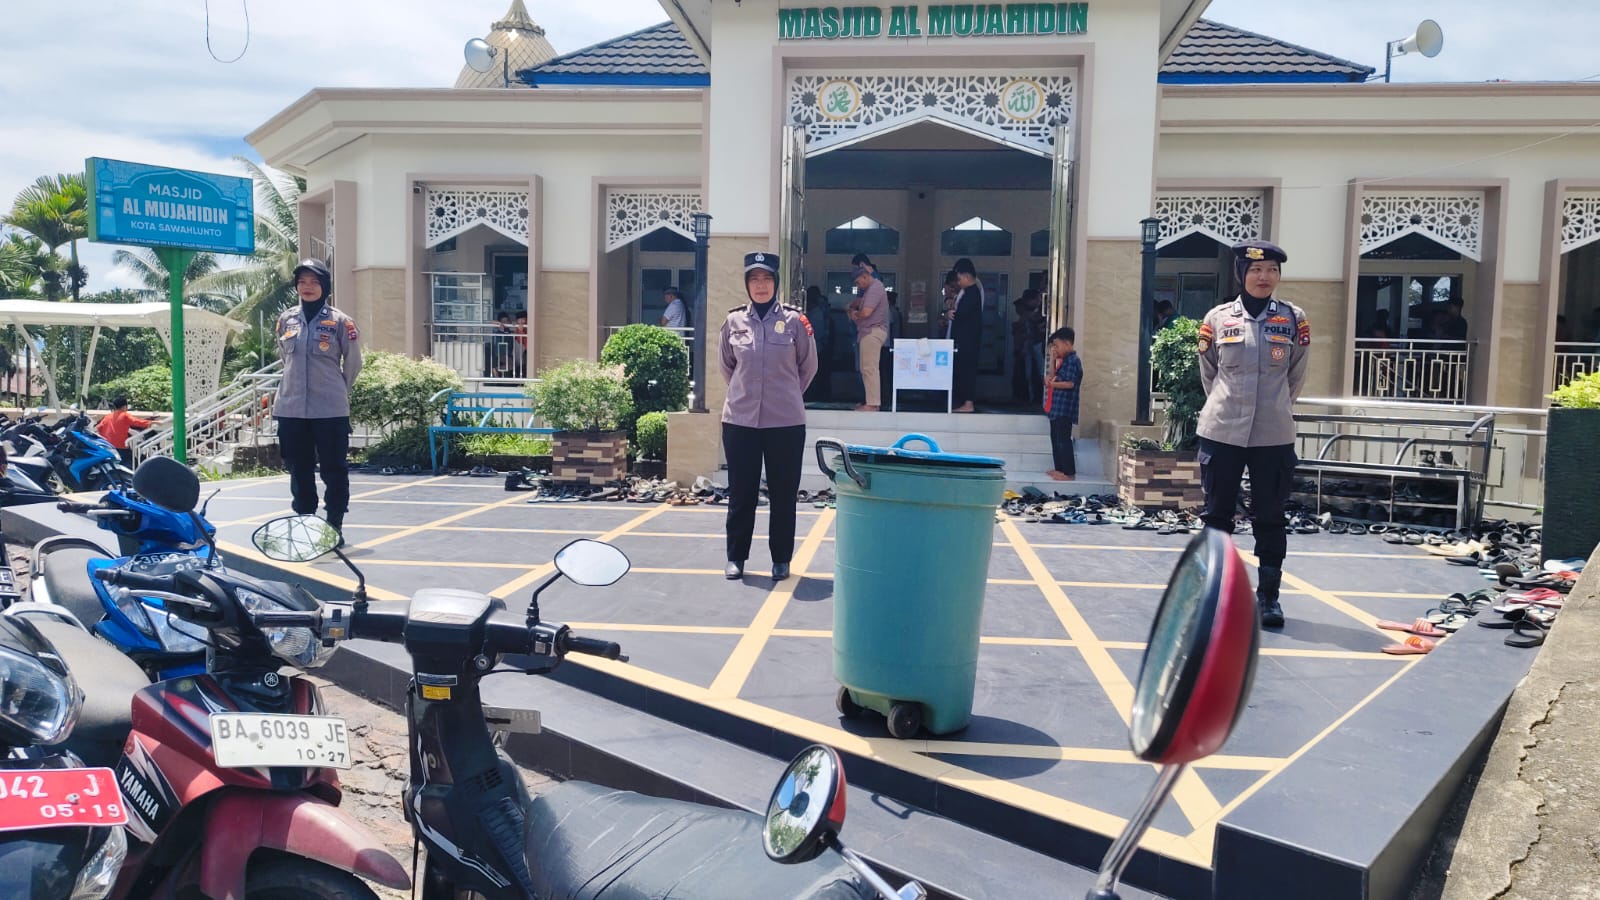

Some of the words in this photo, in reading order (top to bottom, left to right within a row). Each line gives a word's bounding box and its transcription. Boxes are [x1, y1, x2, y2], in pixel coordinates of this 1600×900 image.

[778, 6, 882, 39] MASJID
[887, 6, 922, 37] AL
[927, 2, 1088, 36] MUJAHIDIN
[148, 183, 203, 199] MASJID
[122, 197, 141, 216] AL
[145, 200, 228, 224] MUJAHIDIN
[130, 220, 156, 231] KOTA
[158, 223, 222, 237] SAWAHLUNTO
[219, 719, 249, 739] BA
[260, 719, 310, 740] 6039
[325, 723, 345, 743] JE
[82, 774, 100, 796] J
[121, 767, 160, 820] YAMAHA
